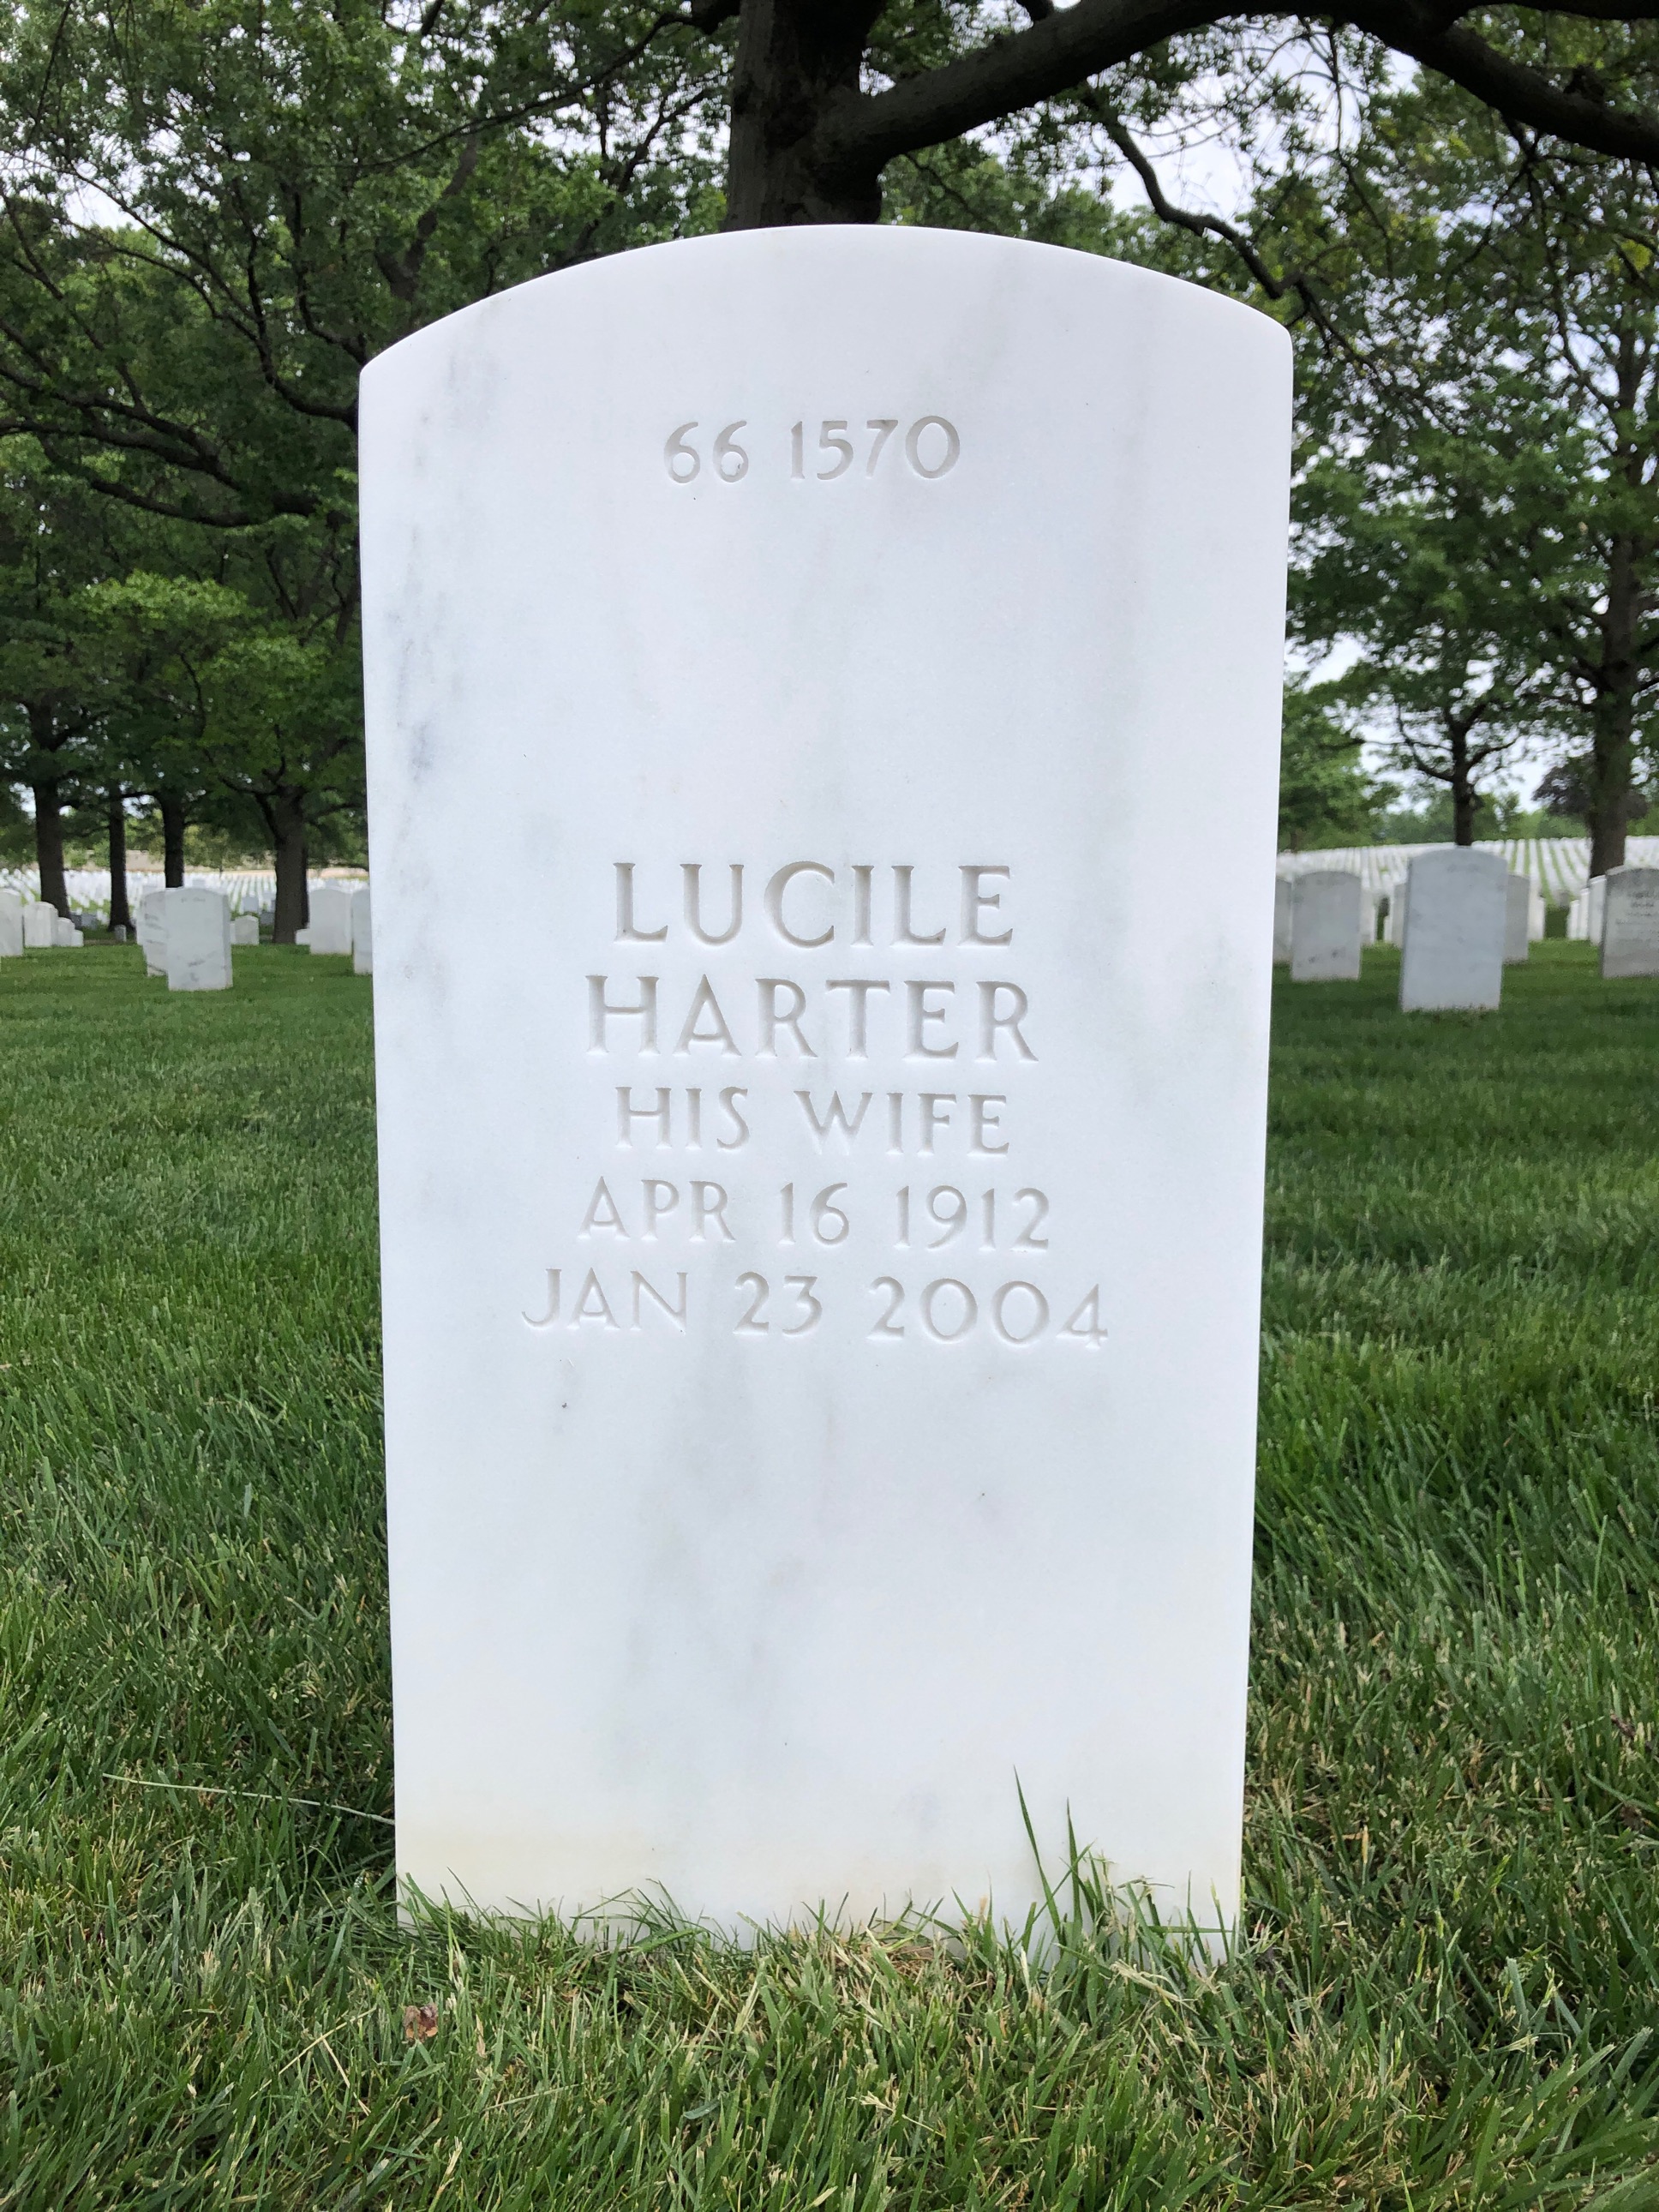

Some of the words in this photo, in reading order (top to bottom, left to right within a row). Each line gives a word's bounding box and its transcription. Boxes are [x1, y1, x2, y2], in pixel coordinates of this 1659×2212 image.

[663, 420, 750, 484] 66
[789, 415, 961, 481] 1570
[613, 861, 1014, 949] LUCILE
[585, 974, 1039, 1062] HARTER
[614, 1085, 751, 1152] HIS
[793, 1090, 1010, 1156] WIFE
[577, 1175, 736, 1244] APR
[777, 1182, 850, 1246] 16
[895, 1184, 1050, 1253] 1912
[522, 1267, 688, 1334] JAN
[733, 1272, 823, 1338] 23
[865, 1275, 1108, 1348] 2004
